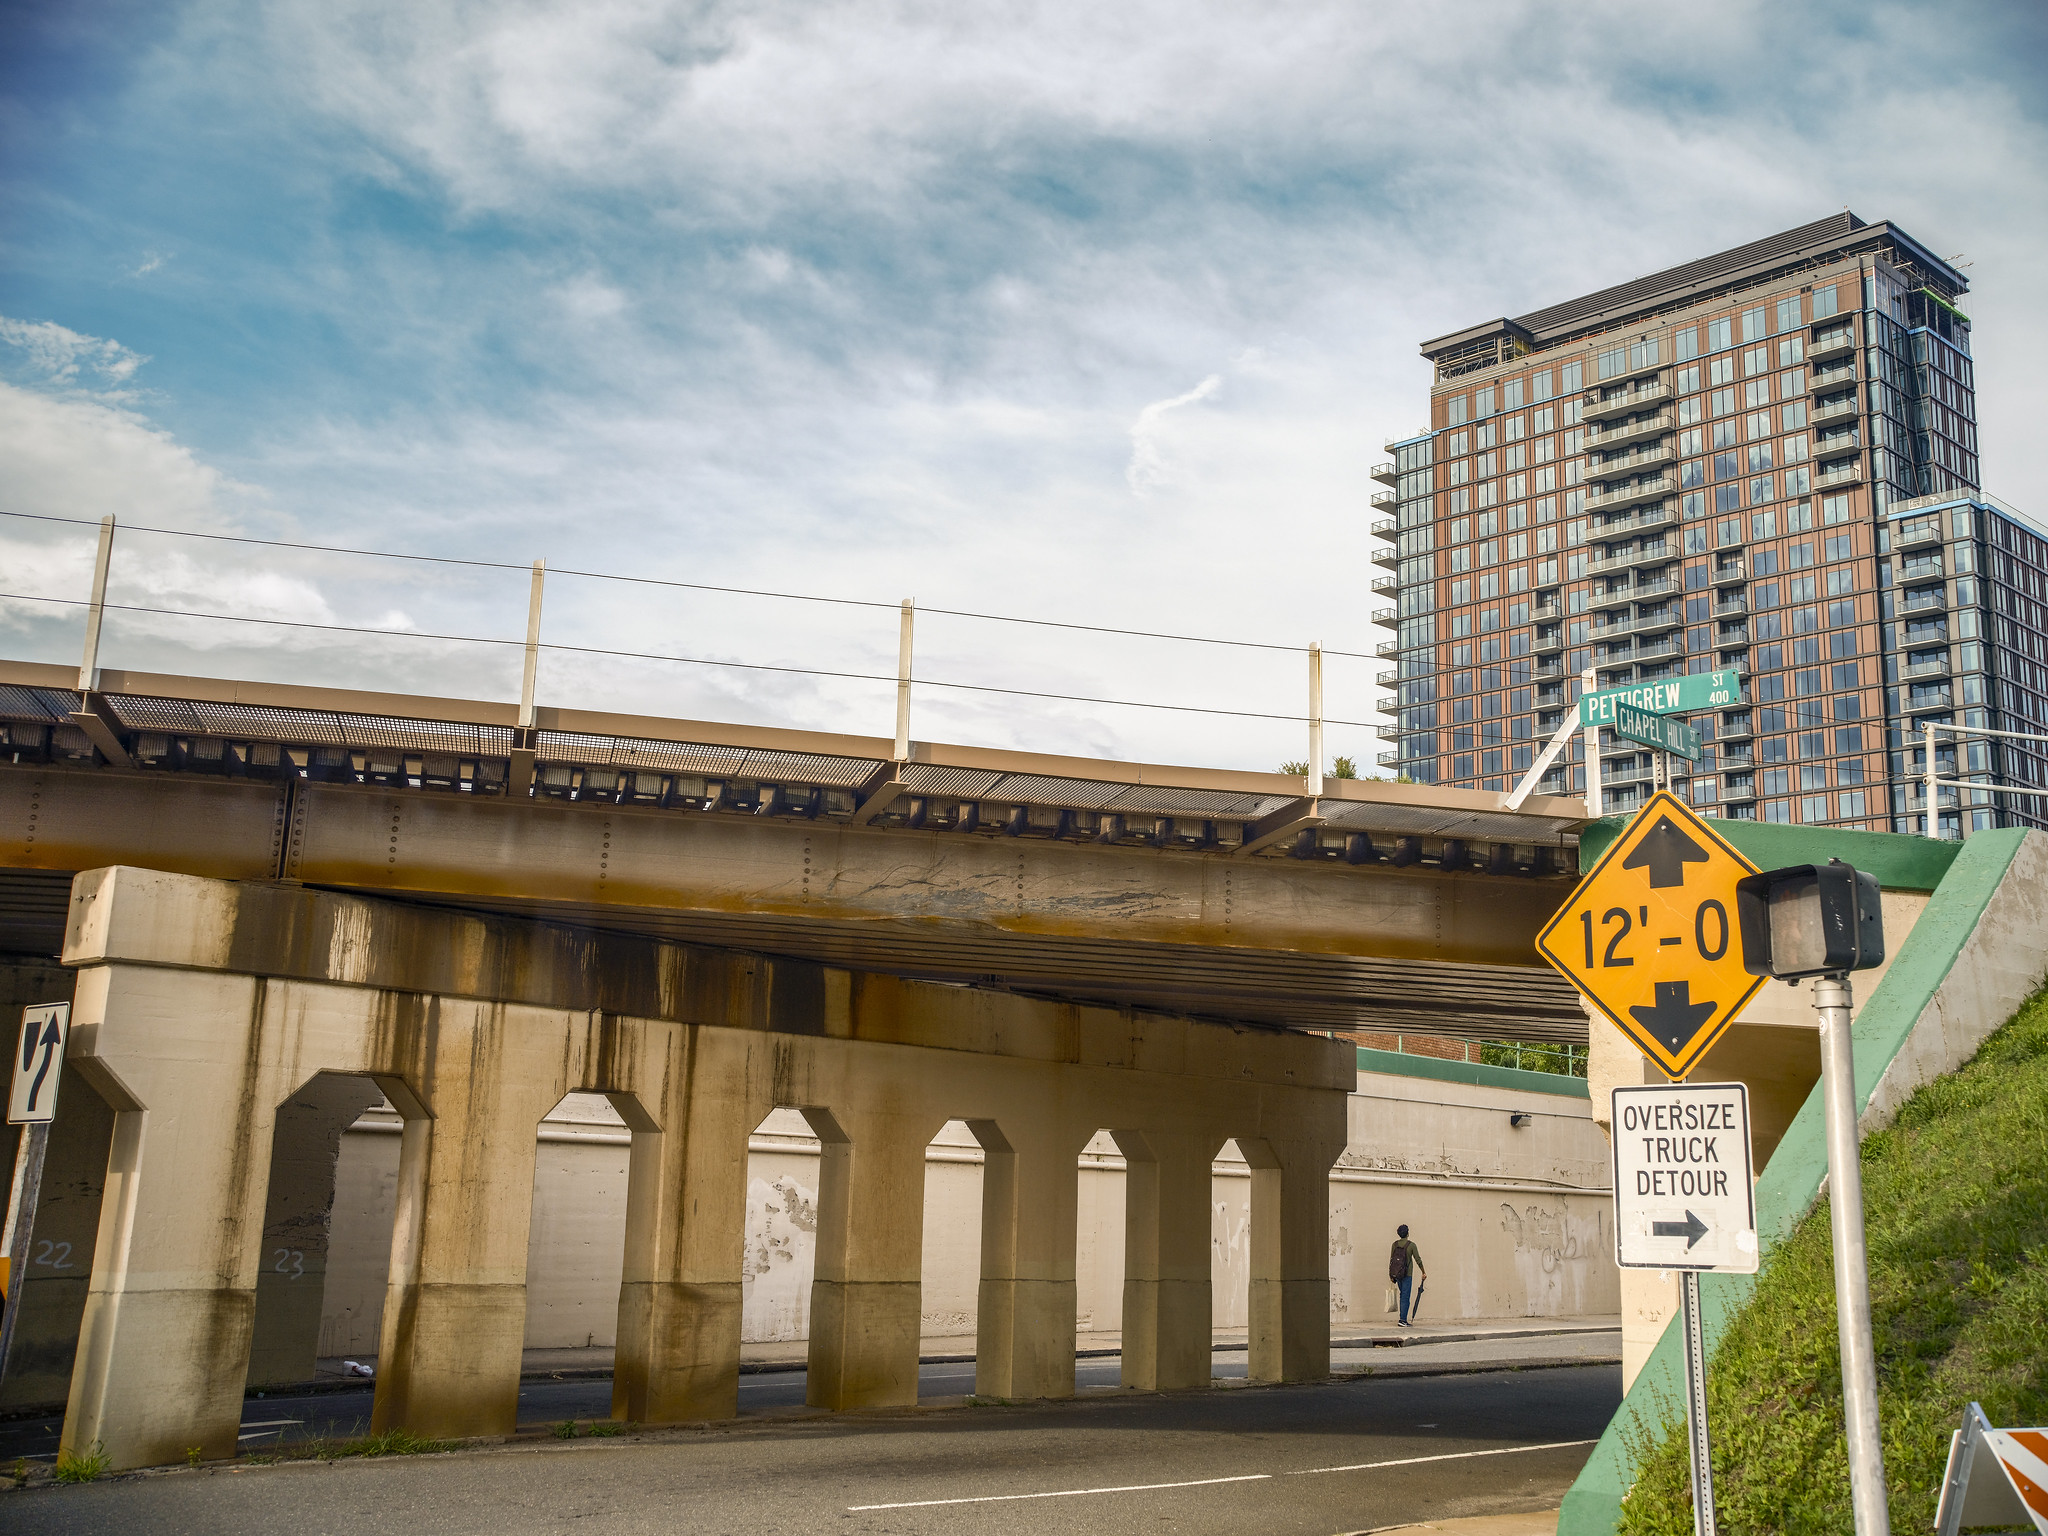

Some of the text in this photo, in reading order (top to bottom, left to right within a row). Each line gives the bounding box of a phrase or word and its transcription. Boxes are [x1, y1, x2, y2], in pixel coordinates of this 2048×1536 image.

[1588, 673, 1724, 721] PETTIGREW ST
[1709, 690, 1729, 705] 400
[1619, 707, 1663, 743] CHAPEL
[1666, 722, 1685, 752] HILL
[1623, 1103, 1736, 1131] OVERSIZE
[1642, 1136, 1719, 1163] TRUCK
[1636, 1170, 1729, 1197] DETOUR
[35, 1239, 74, 1270] 22
[273, 1248, 306, 1281] 23
